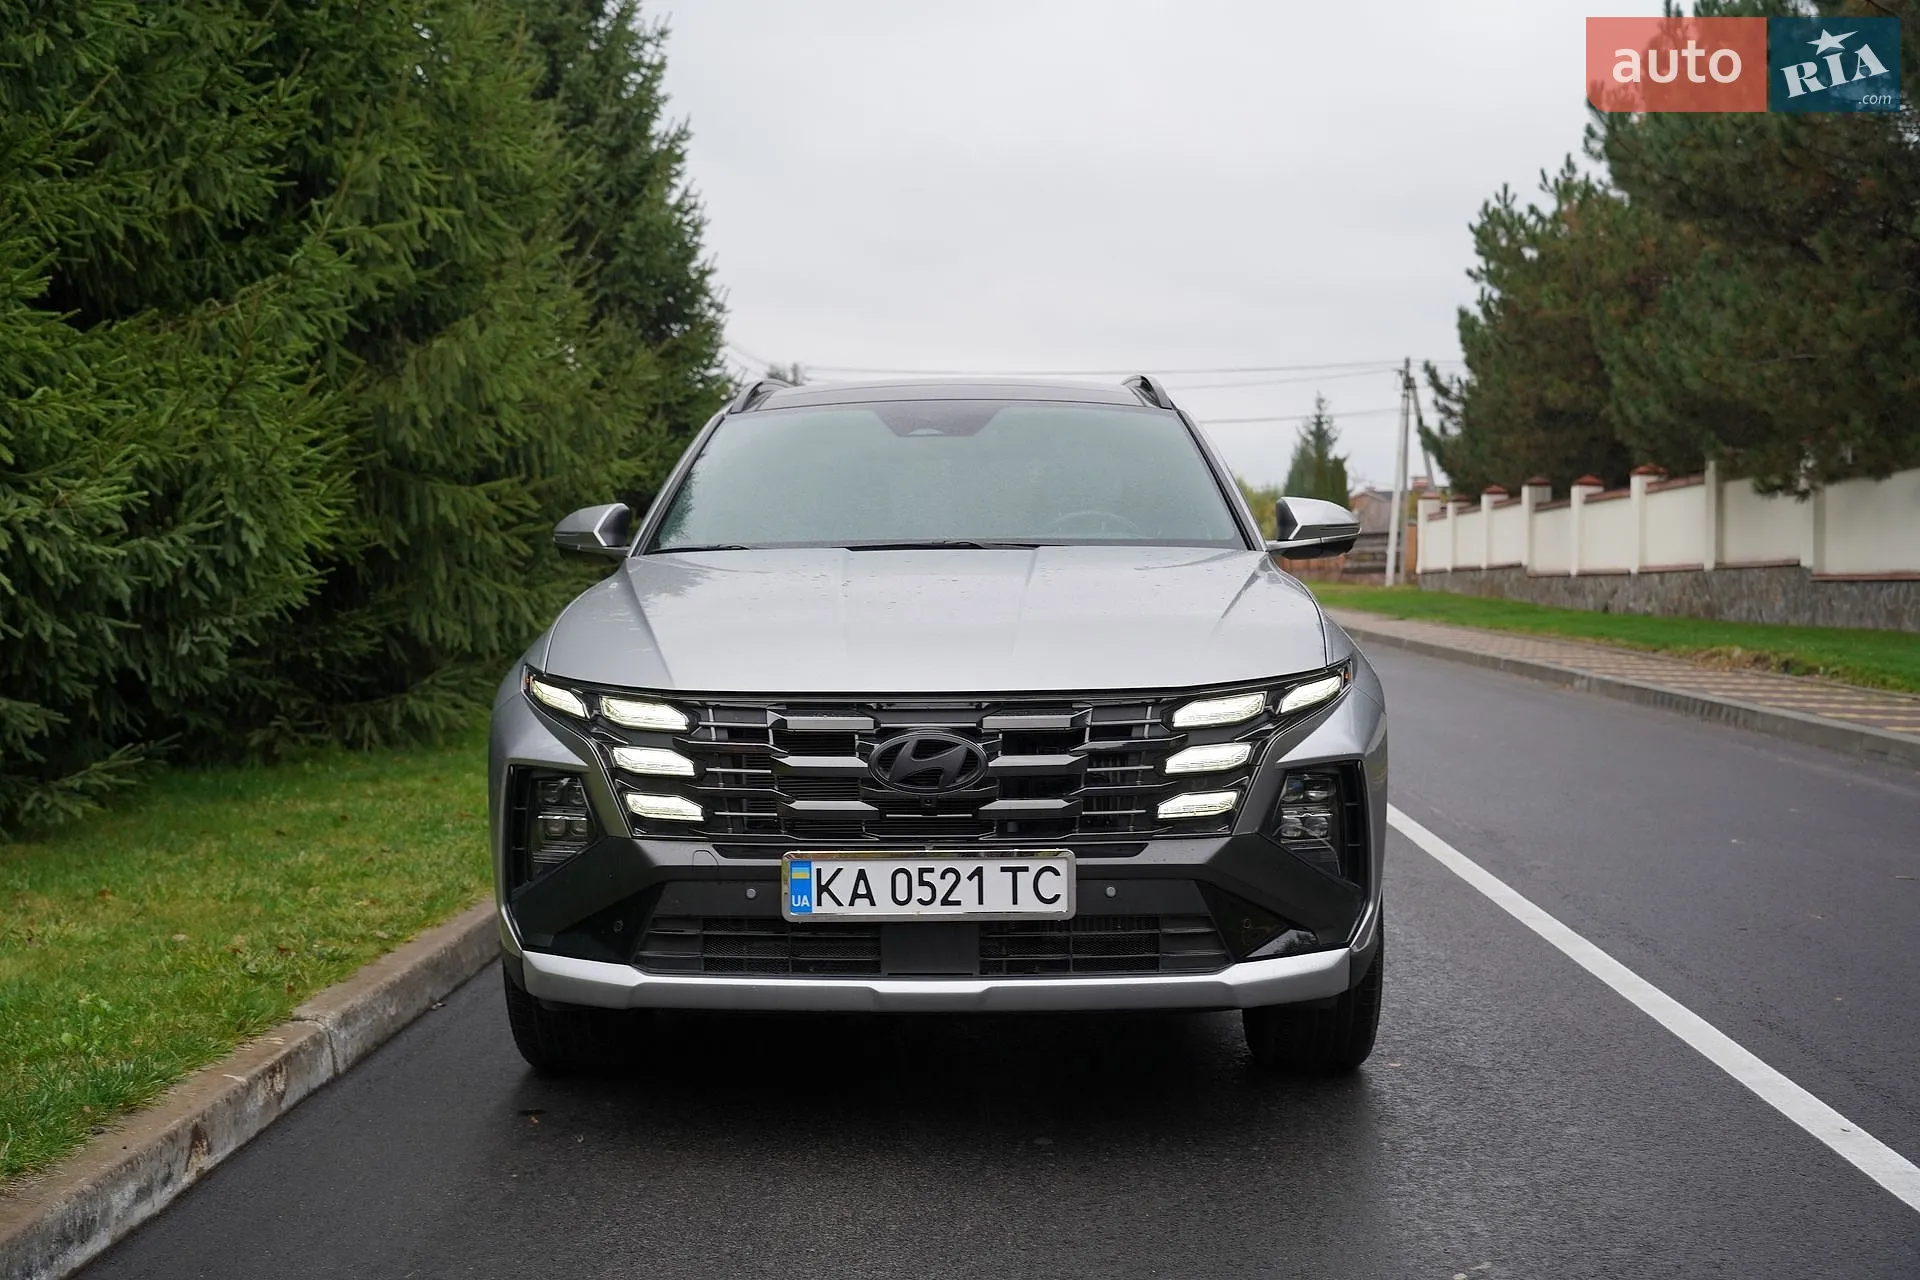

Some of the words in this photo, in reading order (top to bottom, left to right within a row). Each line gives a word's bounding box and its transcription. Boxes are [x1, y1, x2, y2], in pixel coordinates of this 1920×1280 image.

[816, 867, 877, 907] KA
[890, 865, 984, 907] 0521
[1000, 865, 1061, 905] TC
[791, 894, 811, 907] UA
